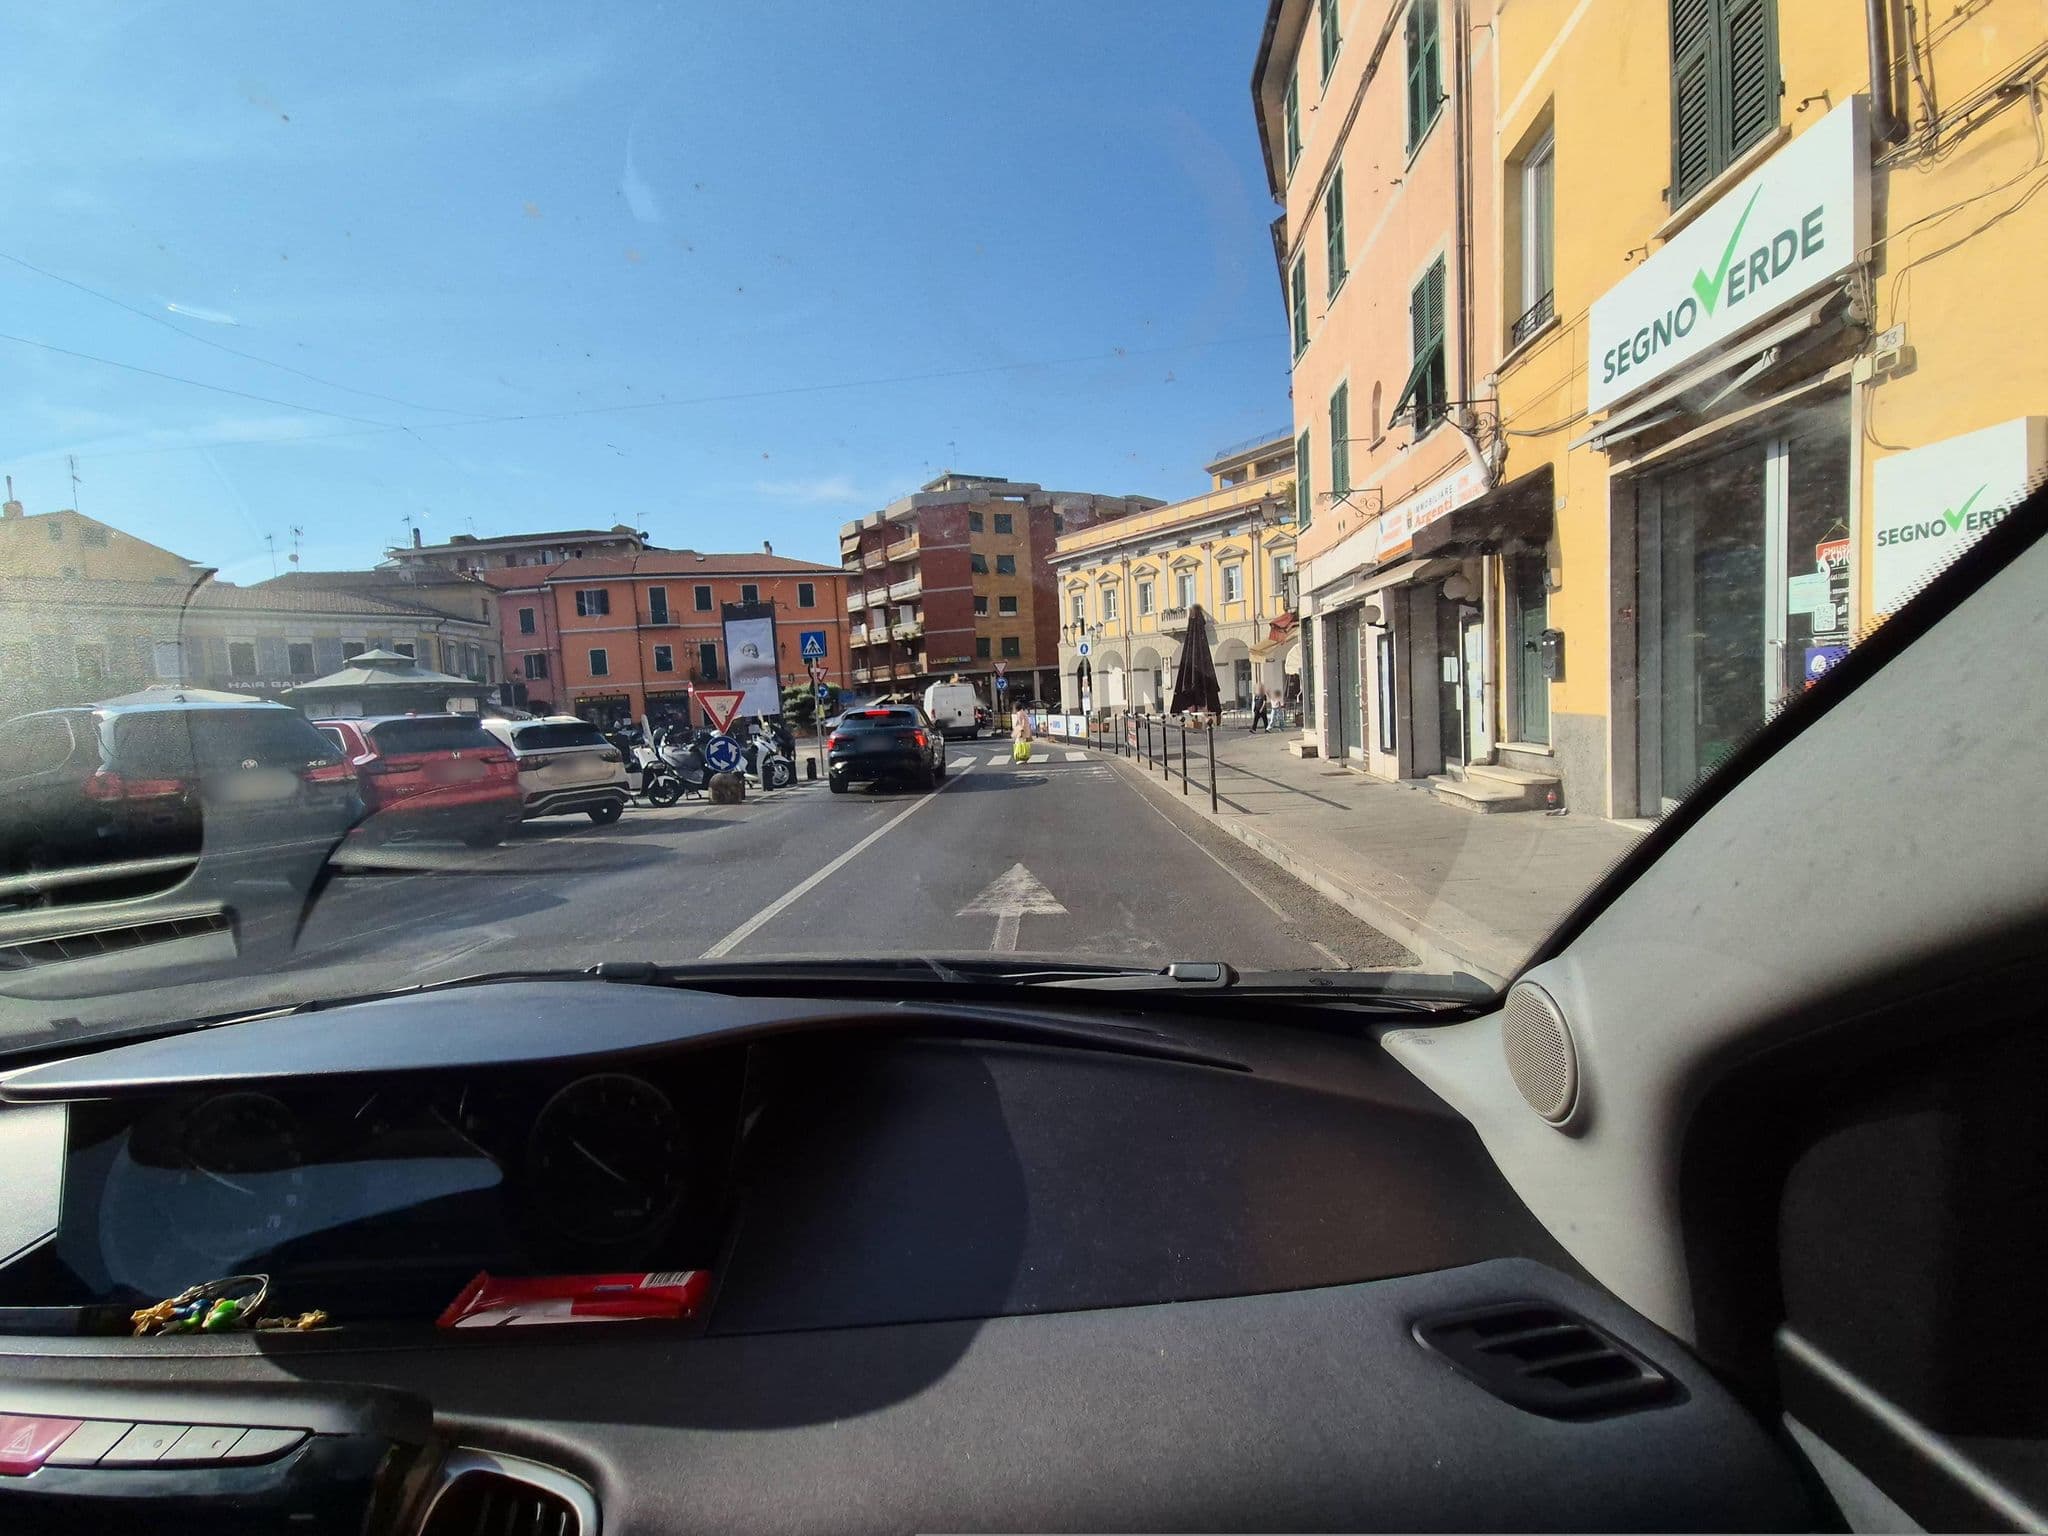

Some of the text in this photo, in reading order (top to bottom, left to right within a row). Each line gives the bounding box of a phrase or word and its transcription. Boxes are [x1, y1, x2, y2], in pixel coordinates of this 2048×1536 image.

[1603, 182, 1824, 384] SEGNOVERDE
[1877, 483, 2008, 547] SEGNOVERD
[228, 681, 264, 689] HAIR
